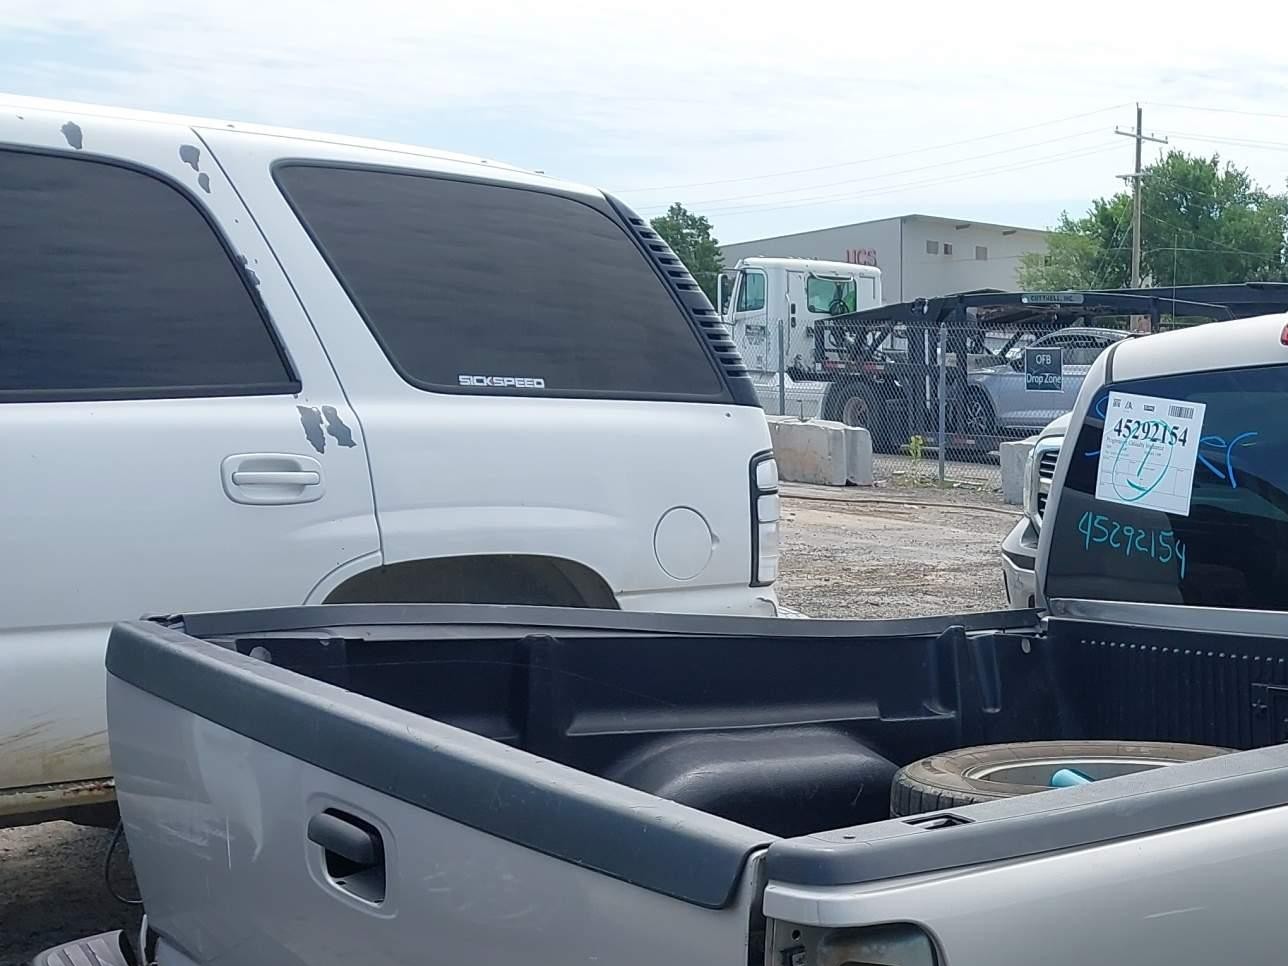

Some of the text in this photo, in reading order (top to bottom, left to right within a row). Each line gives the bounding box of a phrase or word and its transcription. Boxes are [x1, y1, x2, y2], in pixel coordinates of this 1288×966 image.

[1035, 354, 1052, 365] OFB
[458, 375, 545, 389] SICKSPEED
[1026, 373, 1062, 385] Drop Zone
[1113, 417, 1188, 447] 45292154
[1078, 511, 1186, 580] 45292154
